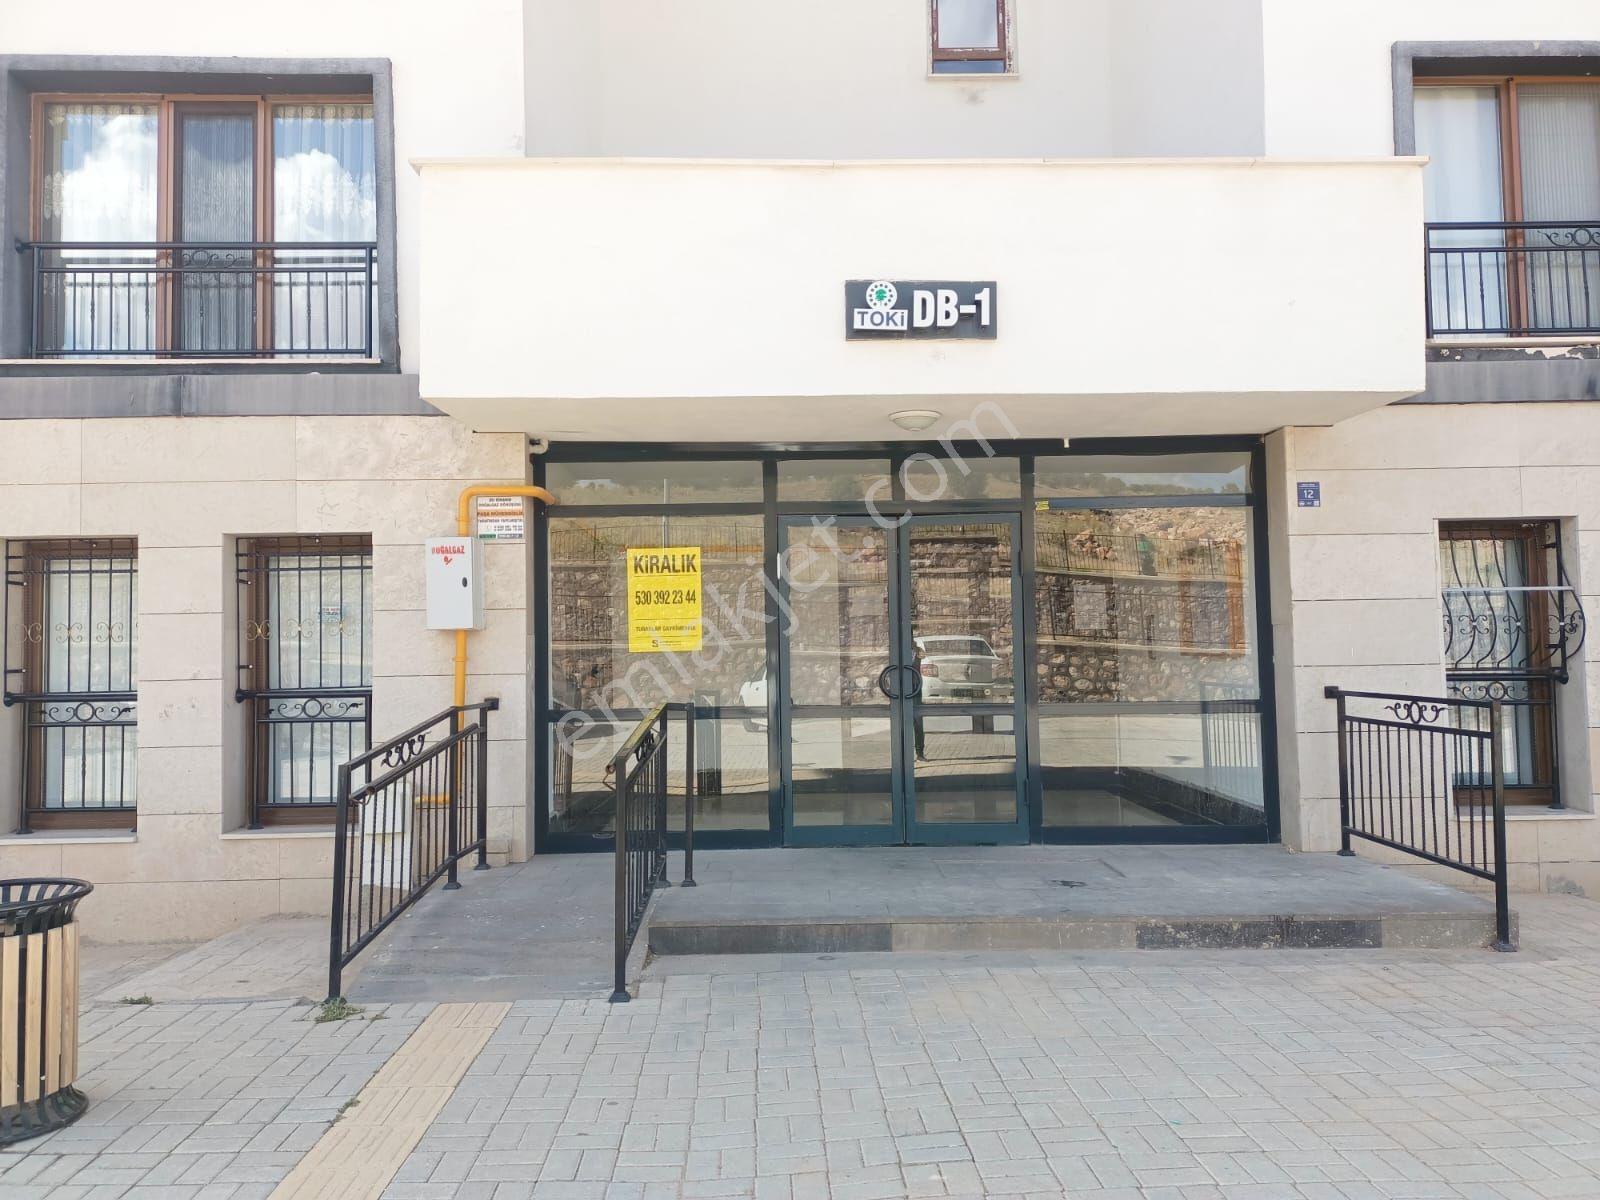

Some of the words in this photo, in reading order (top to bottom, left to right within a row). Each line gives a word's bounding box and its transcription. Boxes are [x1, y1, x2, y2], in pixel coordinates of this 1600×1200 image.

[913, 287, 990, 328] DB-1
[1303, 489, 1314, 499] 12
[635, 590, 652, 606] 530
[653, 590, 670, 605] 392
[672, 589, 683, 605] 23
[685, 589, 697, 605] 44
